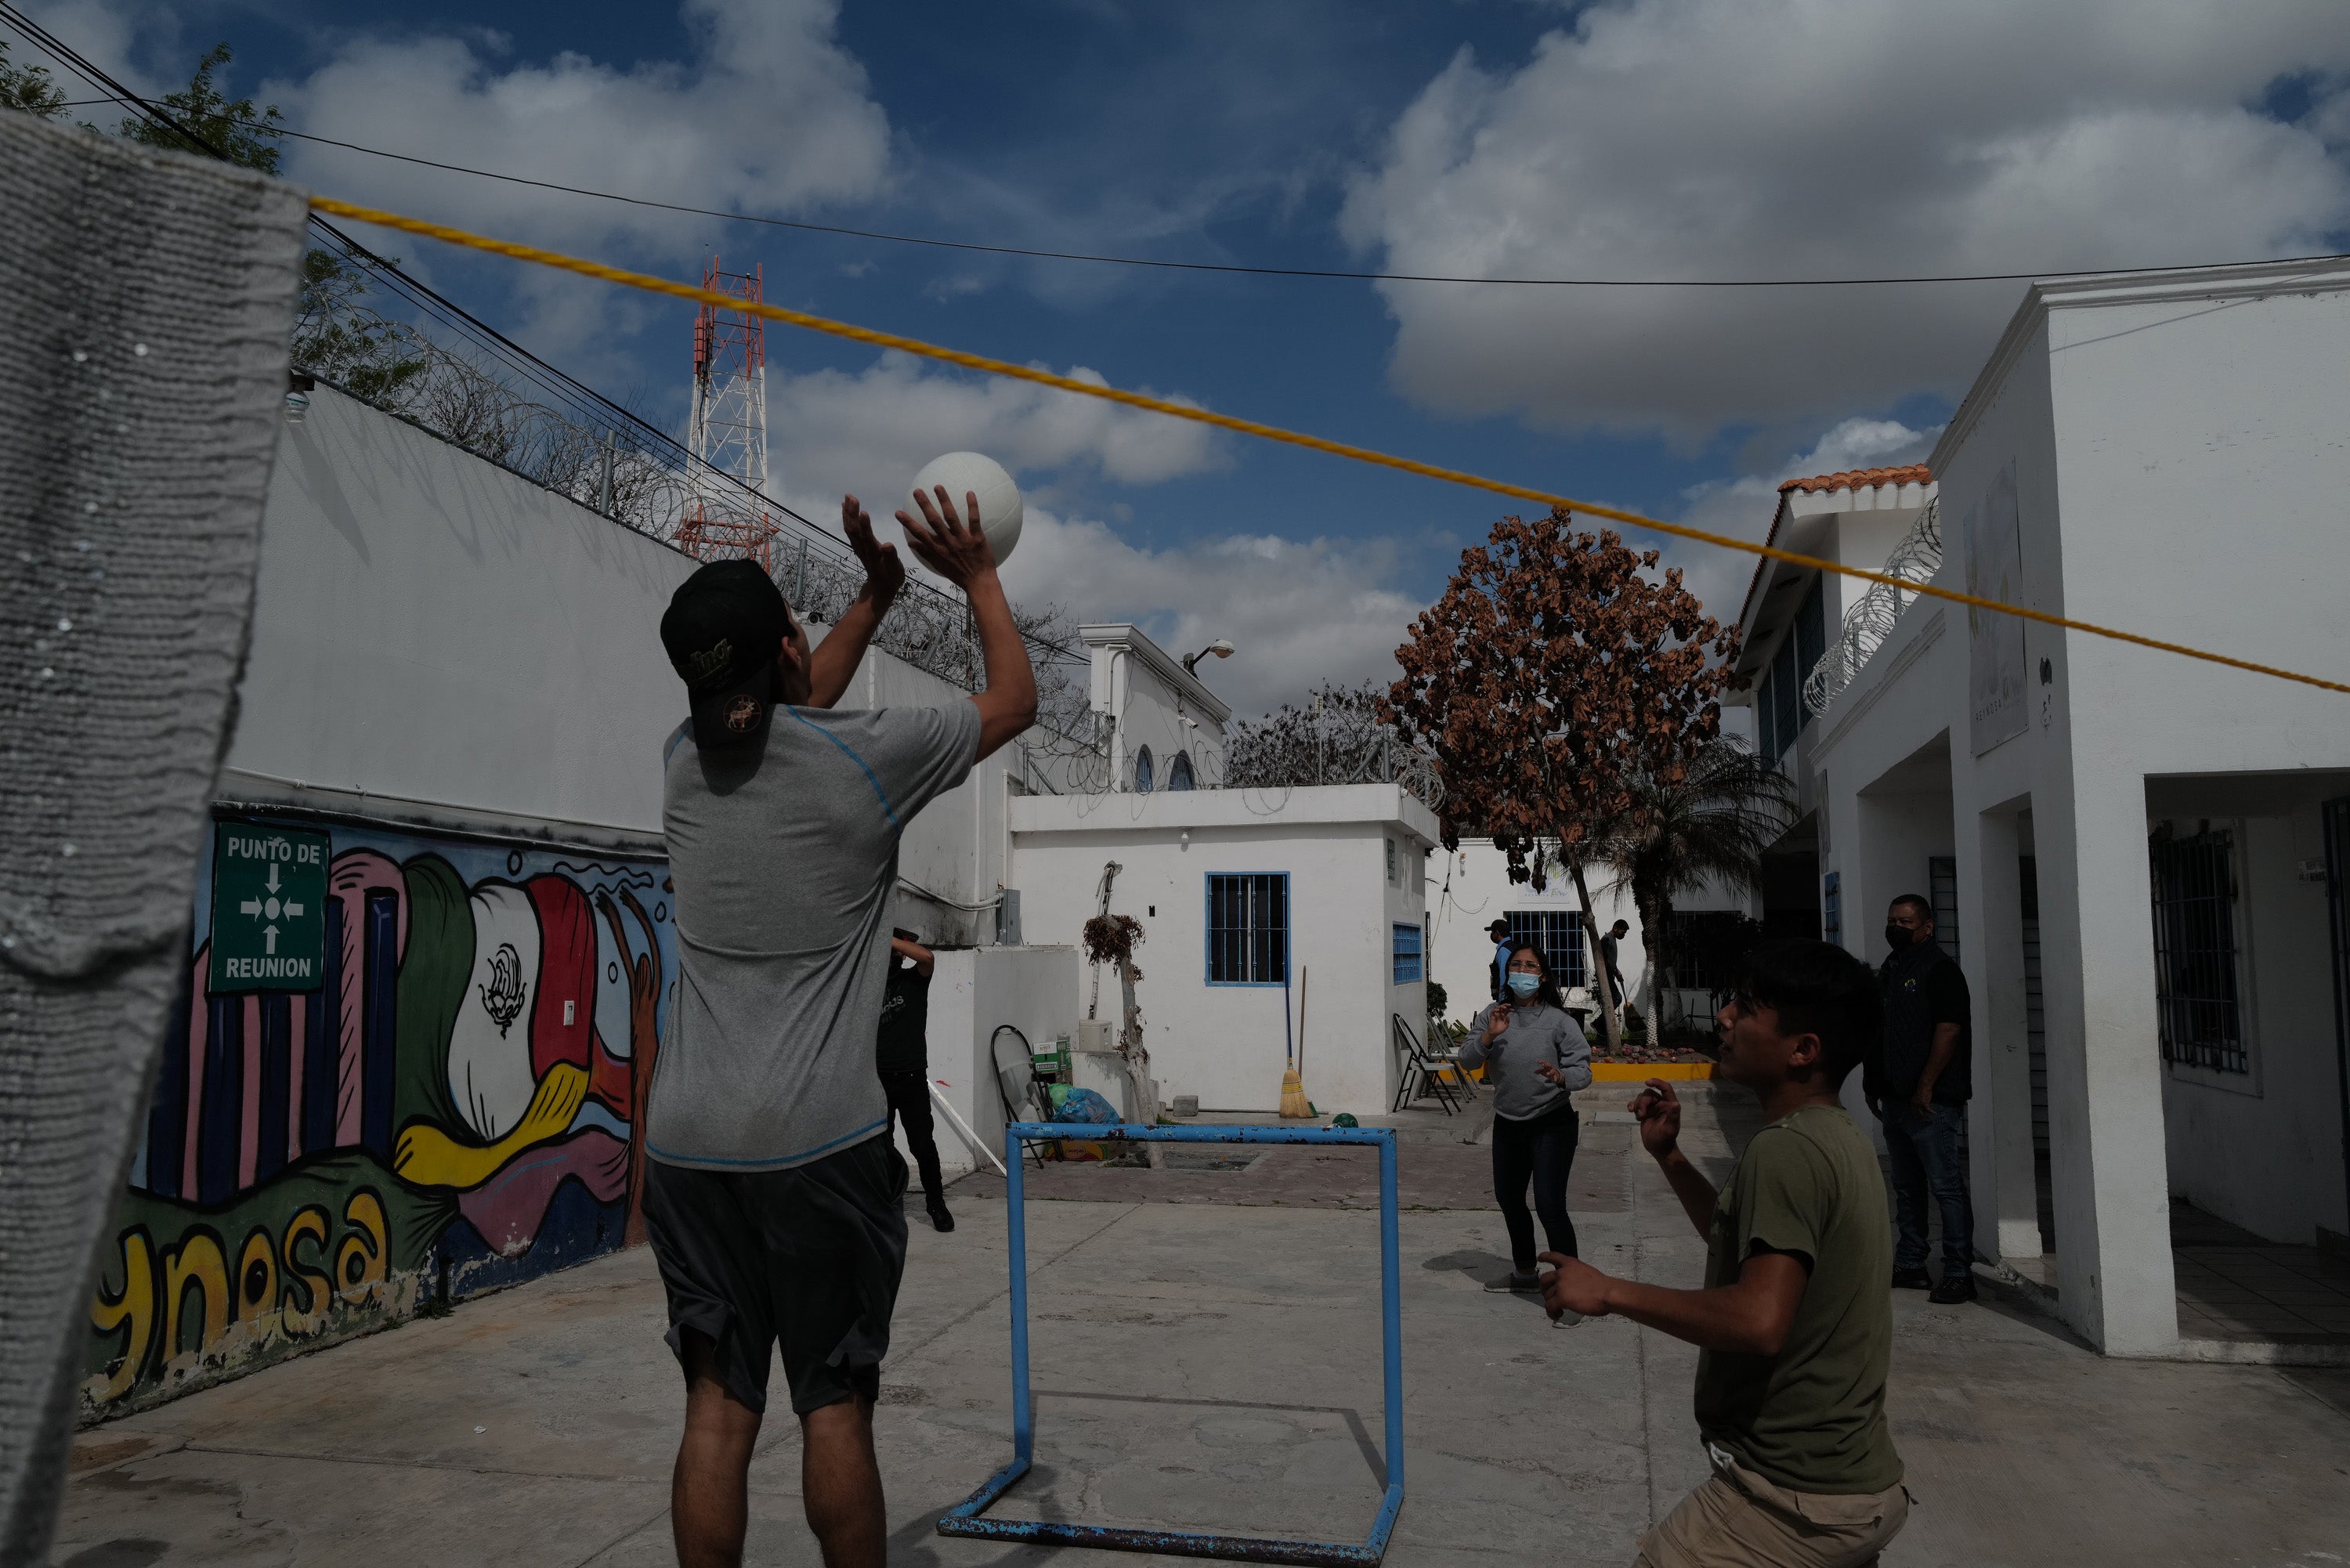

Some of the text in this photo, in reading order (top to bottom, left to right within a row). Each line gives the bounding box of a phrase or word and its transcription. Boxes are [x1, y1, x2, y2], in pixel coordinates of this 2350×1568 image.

[227, 836, 320, 865] PUNTO DE
[226, 958, 311, 978] REUNION
